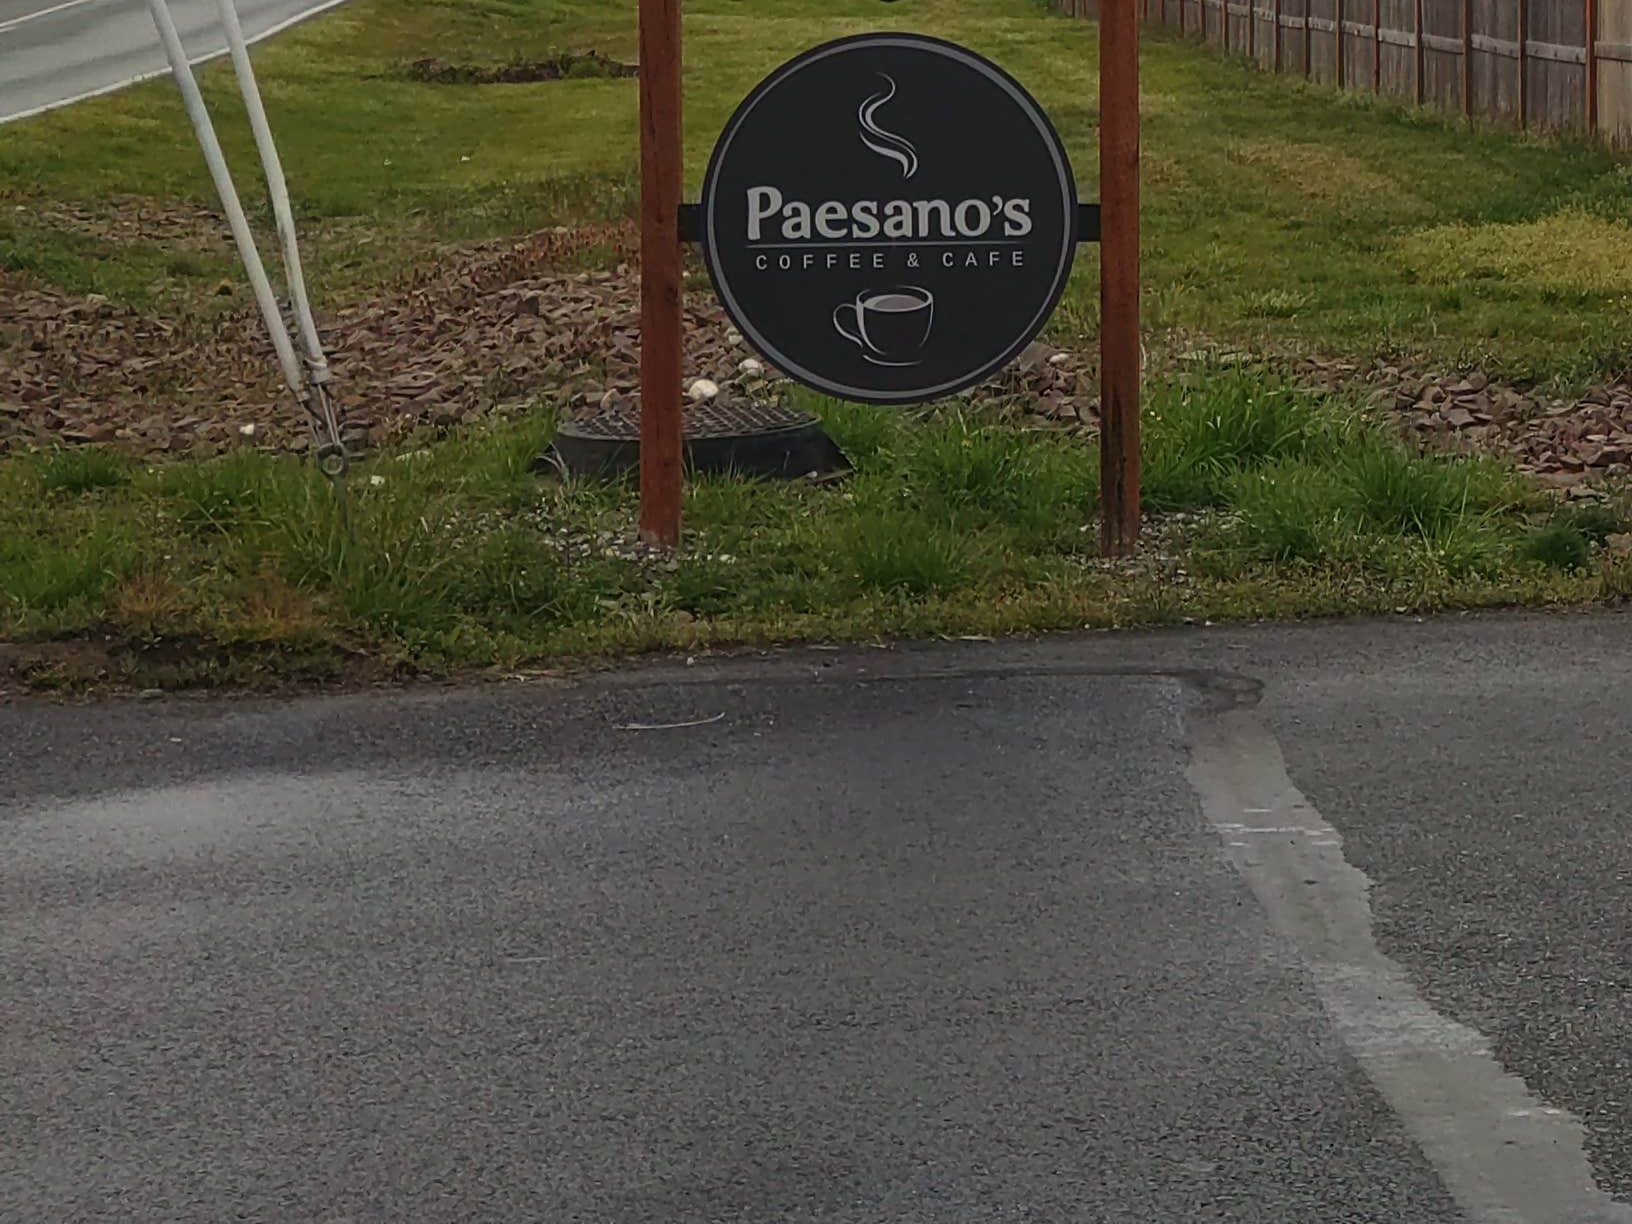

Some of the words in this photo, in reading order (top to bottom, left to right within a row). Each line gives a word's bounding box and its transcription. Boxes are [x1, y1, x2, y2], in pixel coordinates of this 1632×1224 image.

[746, 185, 1033, 241] Paesano's
[755, 253, 884, 269] COFFEE
[907, 252, 920, 268] &
[942, 251, 1023, 267] CAFE
